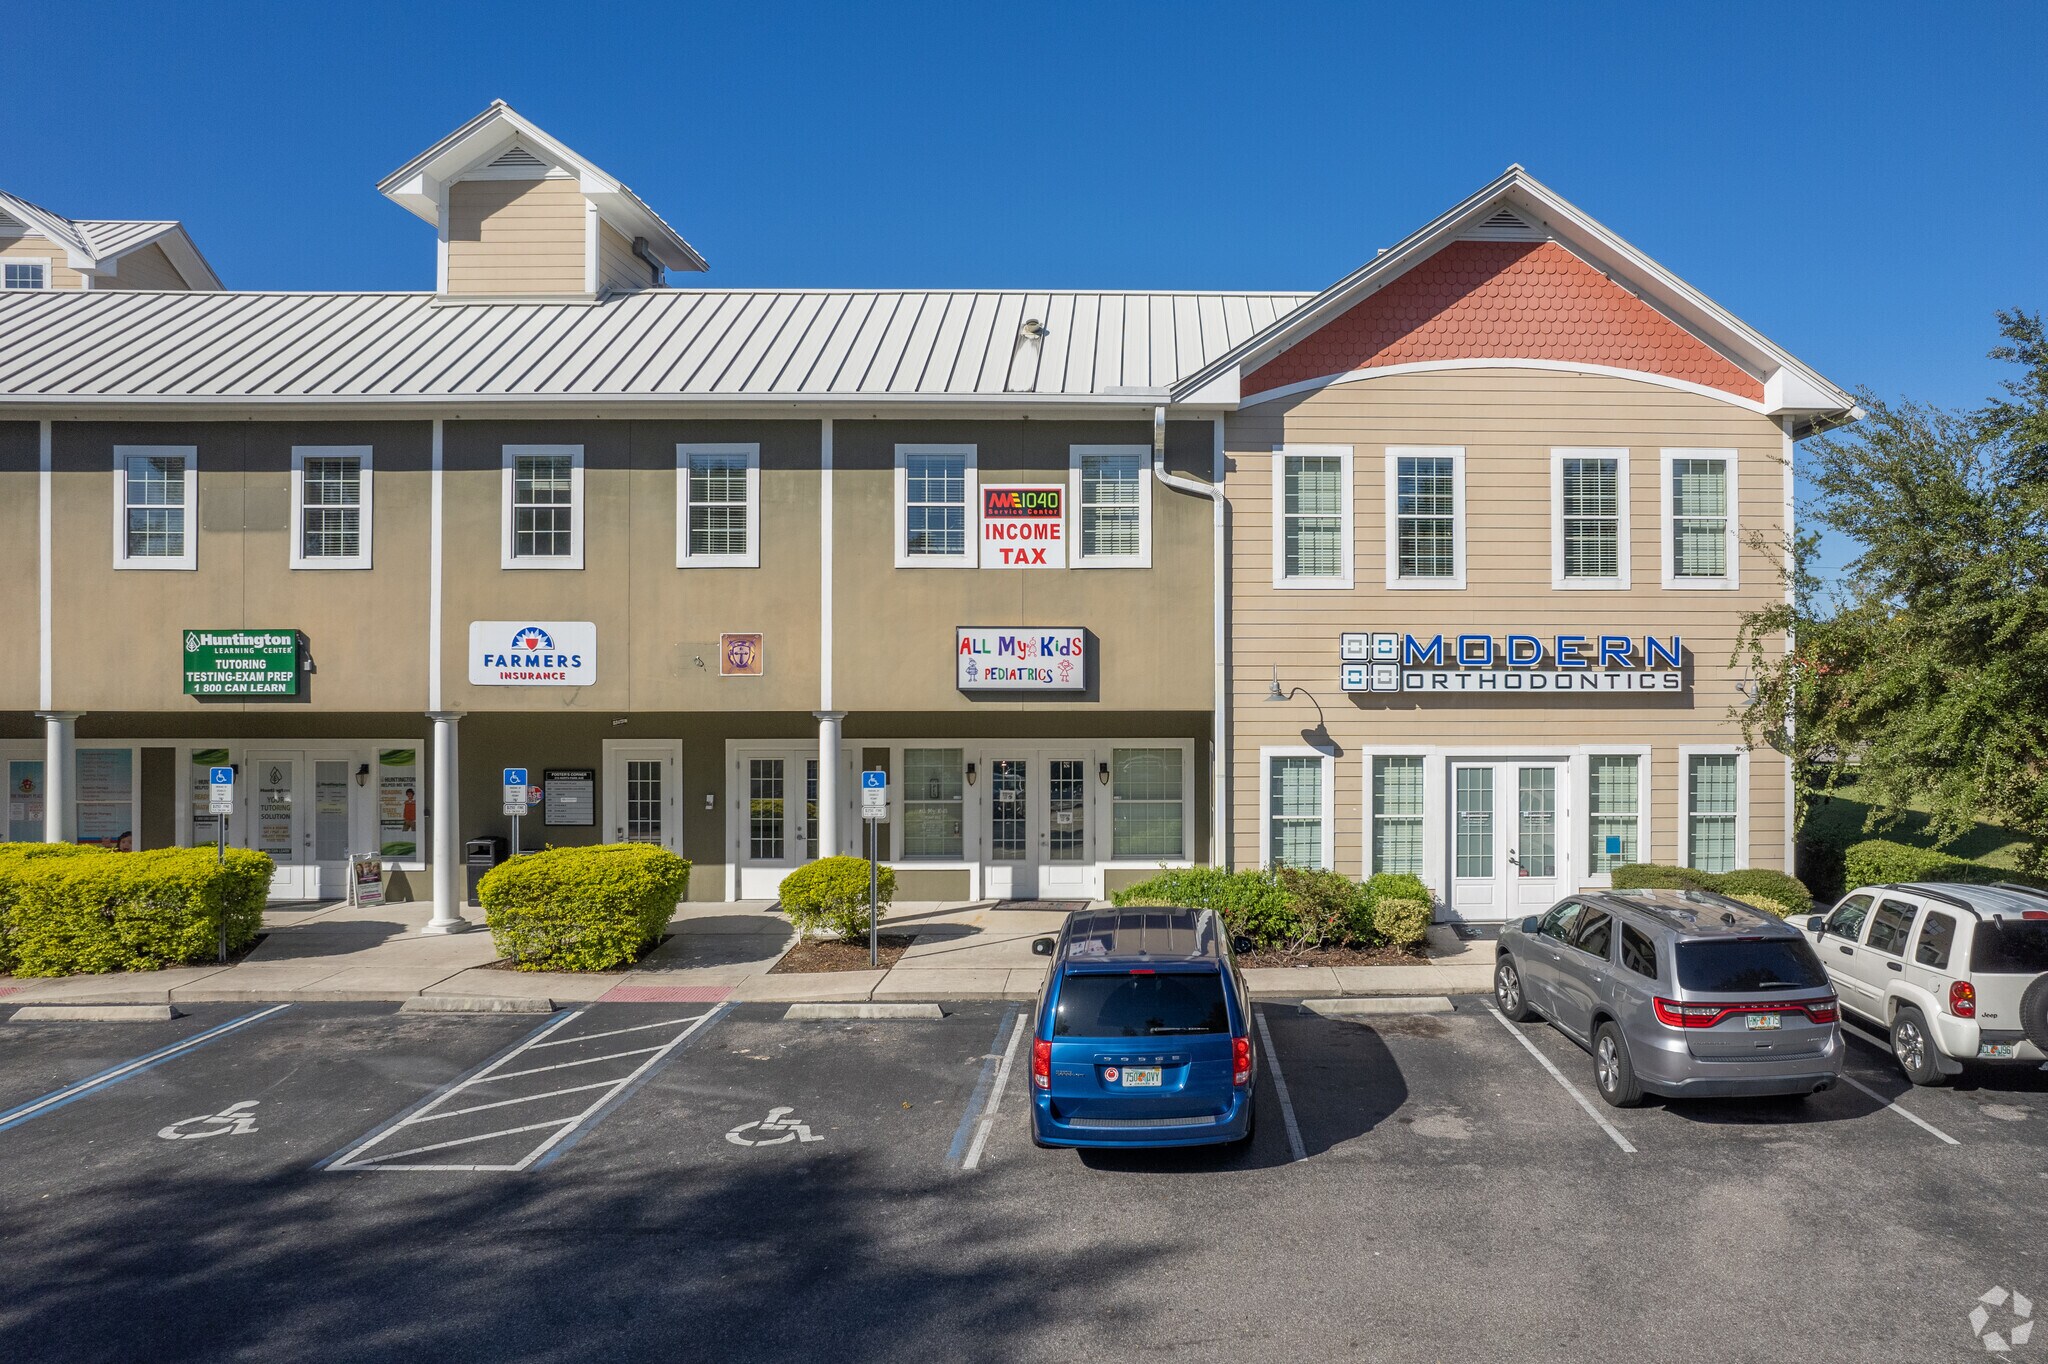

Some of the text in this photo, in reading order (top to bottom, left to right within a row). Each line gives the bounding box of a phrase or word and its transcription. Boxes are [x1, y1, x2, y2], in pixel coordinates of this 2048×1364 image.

[985, 523, 1061, 540] INCOME
[999, 548, 1047, 565] TAX
[200, 633, 291, 648] Huntington
[960, 637, 991, 655] ALL
[998, 636, 1027, 660] My
[1403, 634, 1682, 667] MODERN
[215, 659, 266, 669] TUTORING
[484, 654, 582, 668] FARMERS
[186, 672, 293, 682] TESTING-EXAM PREP
[500, 672, 566, 680] INSURANCE
[984, 667, 1053, 683] PEDIATRICS
[1406, 673, 1680, 689] ORTHODONTICS
[194, 684, 286, 692] 1 800 CAN LEARN
